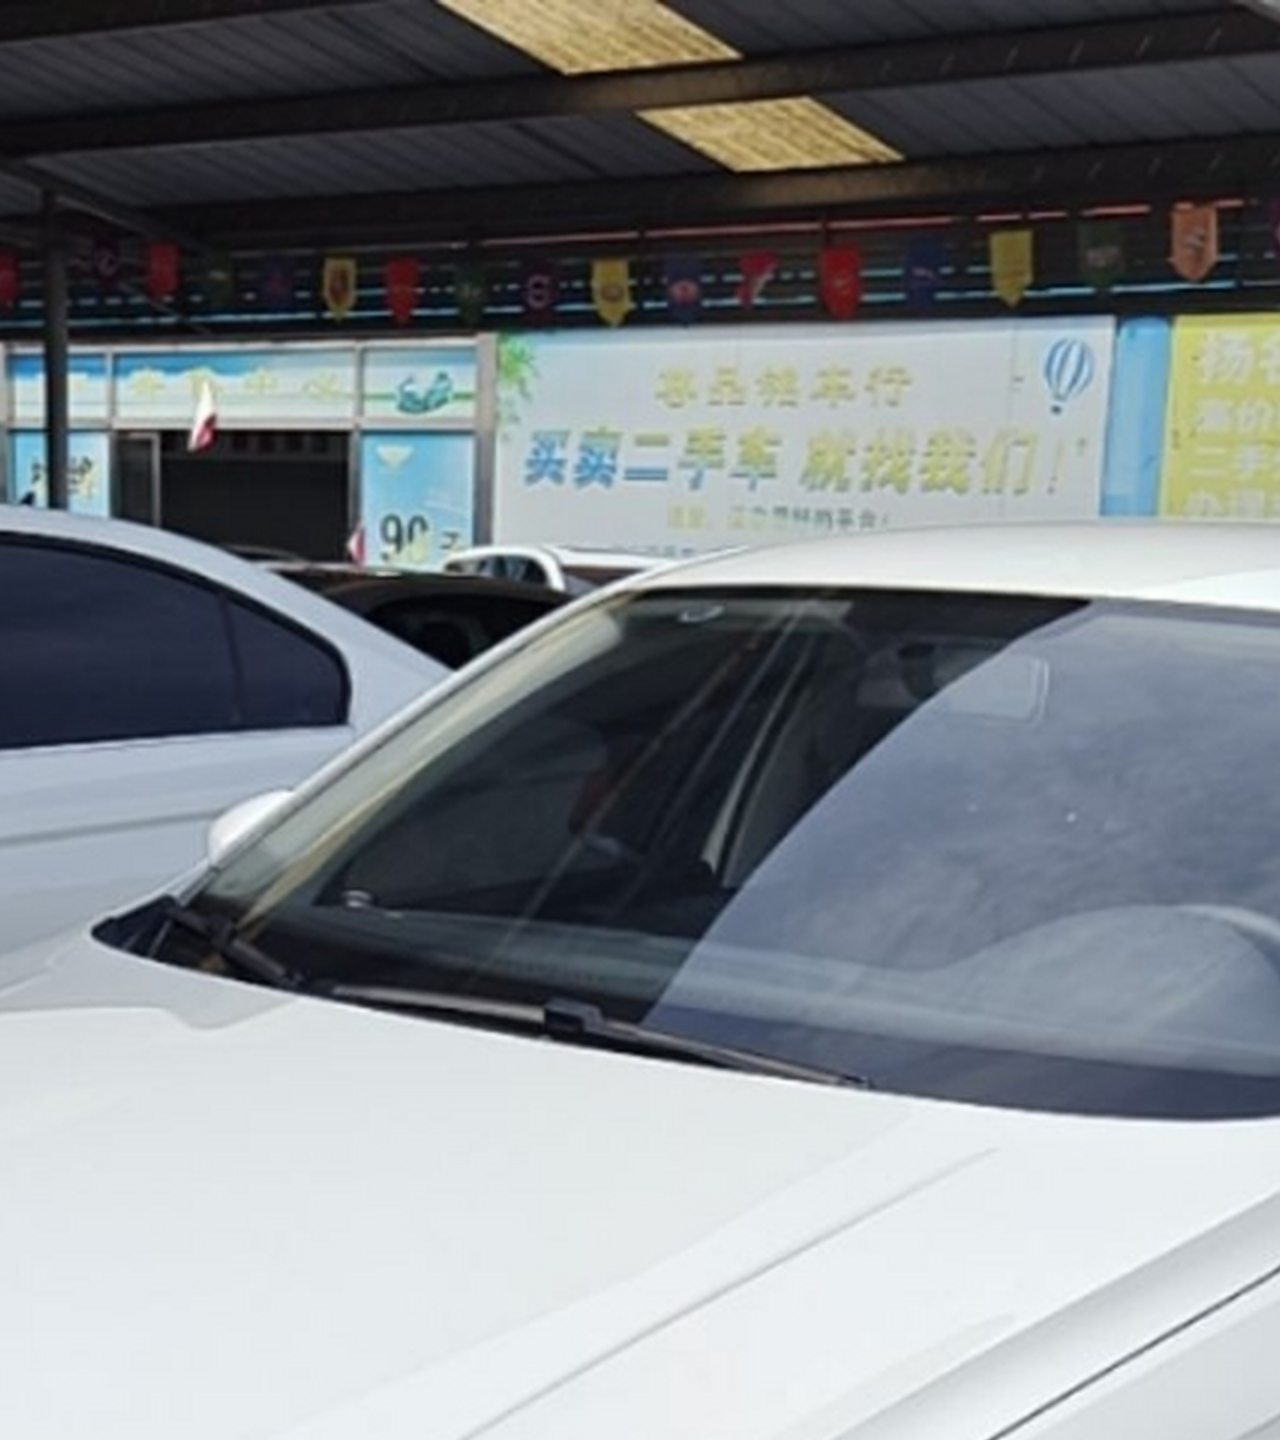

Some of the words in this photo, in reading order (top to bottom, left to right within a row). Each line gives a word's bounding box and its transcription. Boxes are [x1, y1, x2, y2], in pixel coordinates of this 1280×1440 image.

[524, 426, 782, 492] 买卖二手车
